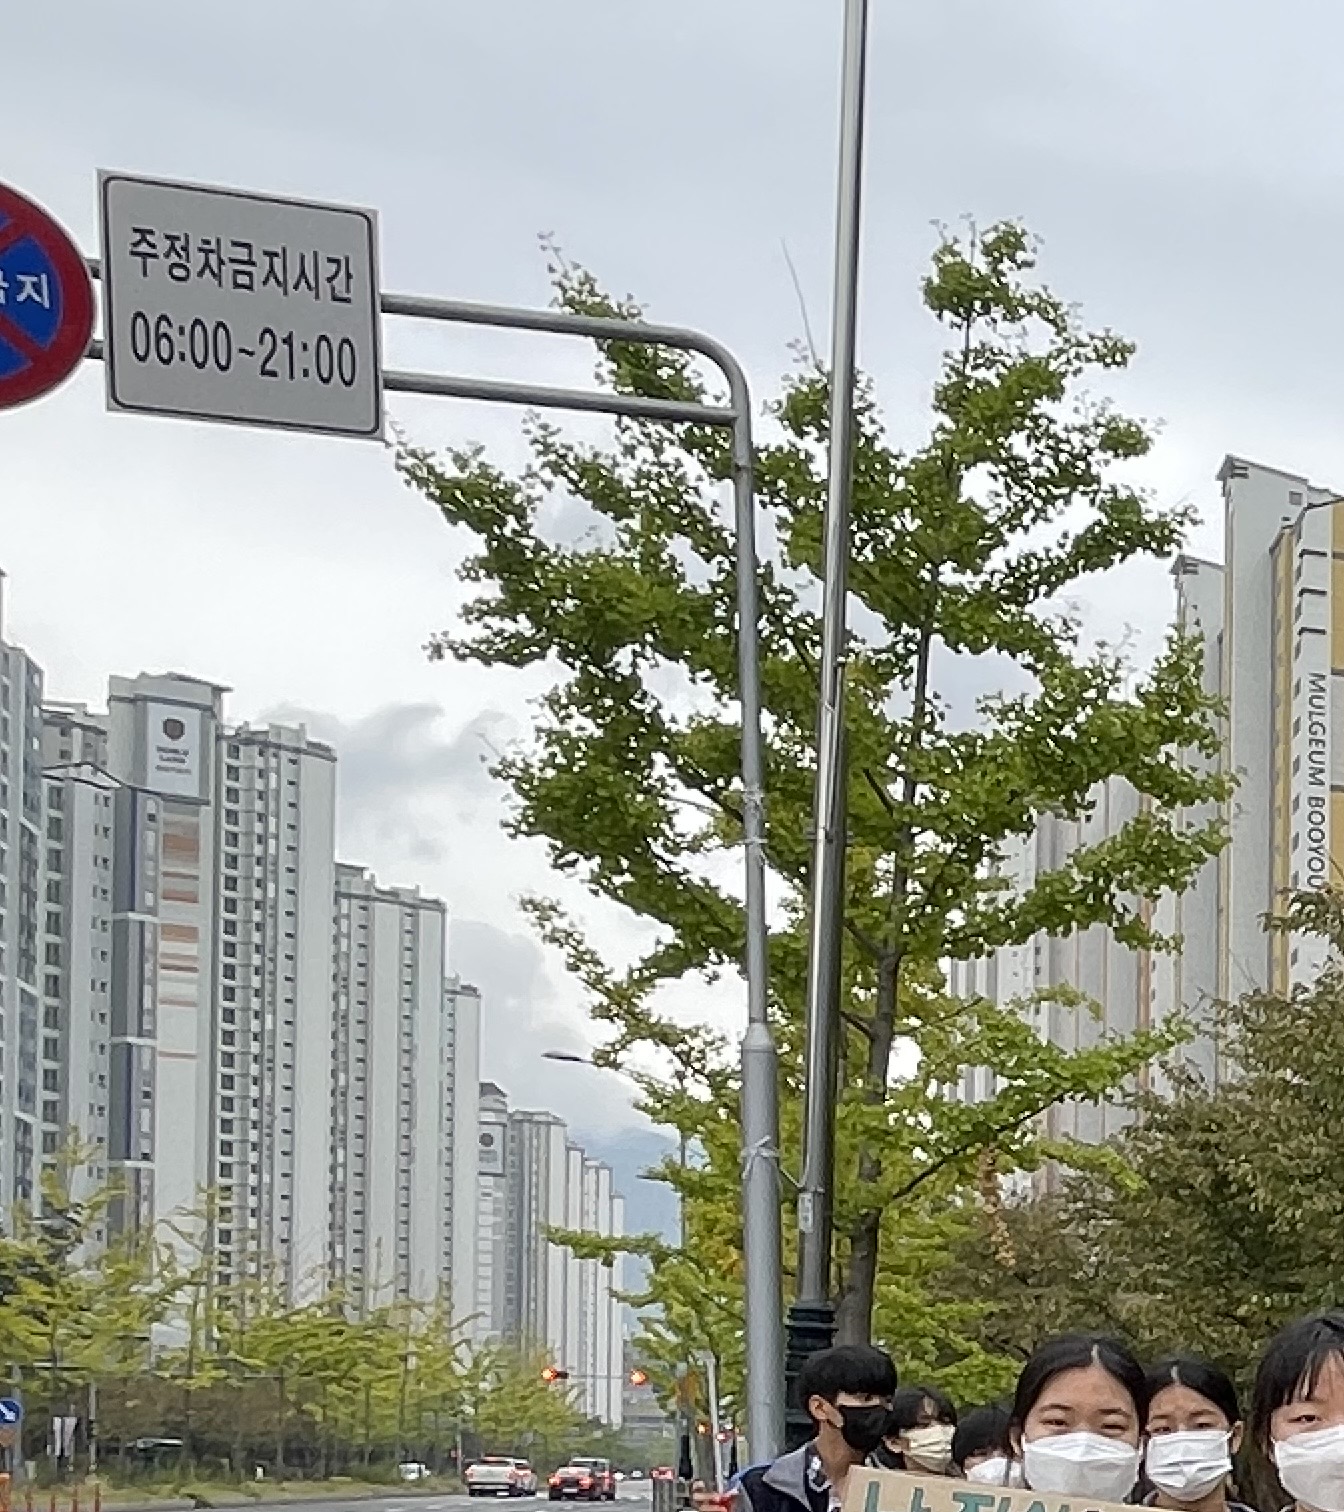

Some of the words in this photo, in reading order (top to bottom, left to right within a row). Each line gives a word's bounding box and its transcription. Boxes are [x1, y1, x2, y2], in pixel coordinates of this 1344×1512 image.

[129, 227, 353, 303] 주정차금지시간
[131, 311, 356, 387] 06:00~21:00
[1307, 673, 1327, 787] MULGEUM
